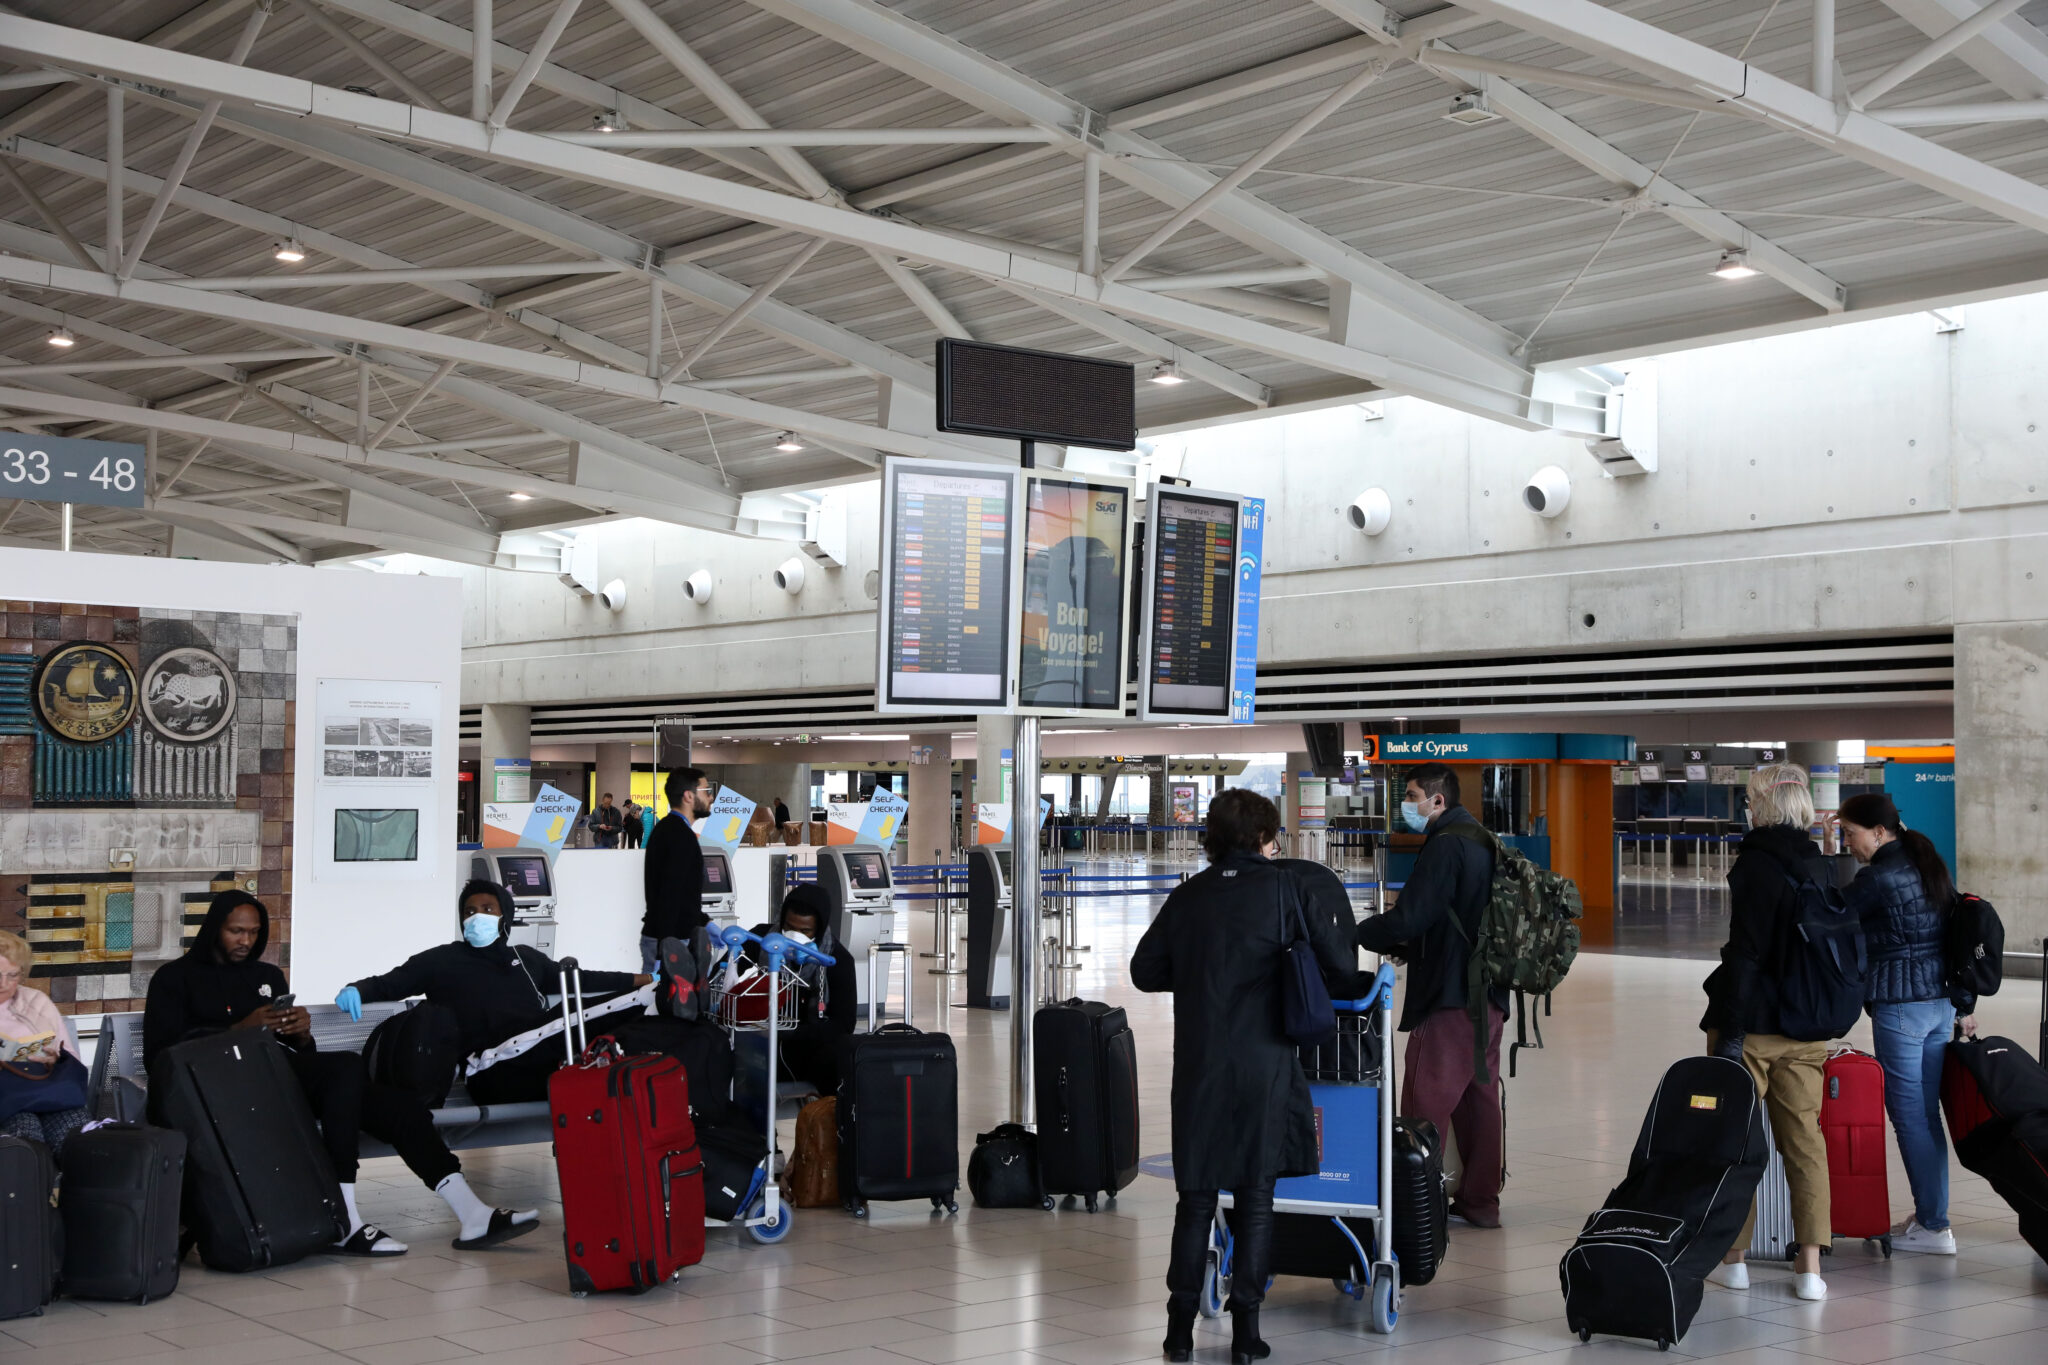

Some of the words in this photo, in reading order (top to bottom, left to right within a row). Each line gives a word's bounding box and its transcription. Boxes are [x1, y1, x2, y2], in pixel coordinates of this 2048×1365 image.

[3, 448, 51, 485] 33
[88, 456, 136, 492] 48
[1056, 602, 1089, 627] Bon
[1038, 627, 1104, 656] Voyage!
[1386, 741, 1410, 753] Bank
[1412, 741, 1424, 753] of
[1425, 740, 1469, 756] Cyprus
[1645, 751, 1654, 761] 31
[1691, 750, 1701, 760] 30
[1763, 750, 1774, 760] 29
[1914, 773, 1927, 782] 24
[541, 794, 565, 803] SELF
[719, 796, 741, 804] SELF
[535, 805, 575, 813] CHECK-IN
[713, 806, 751, 814] CHECK-IN
[869, 805, 904, 813] CHECK-IN
